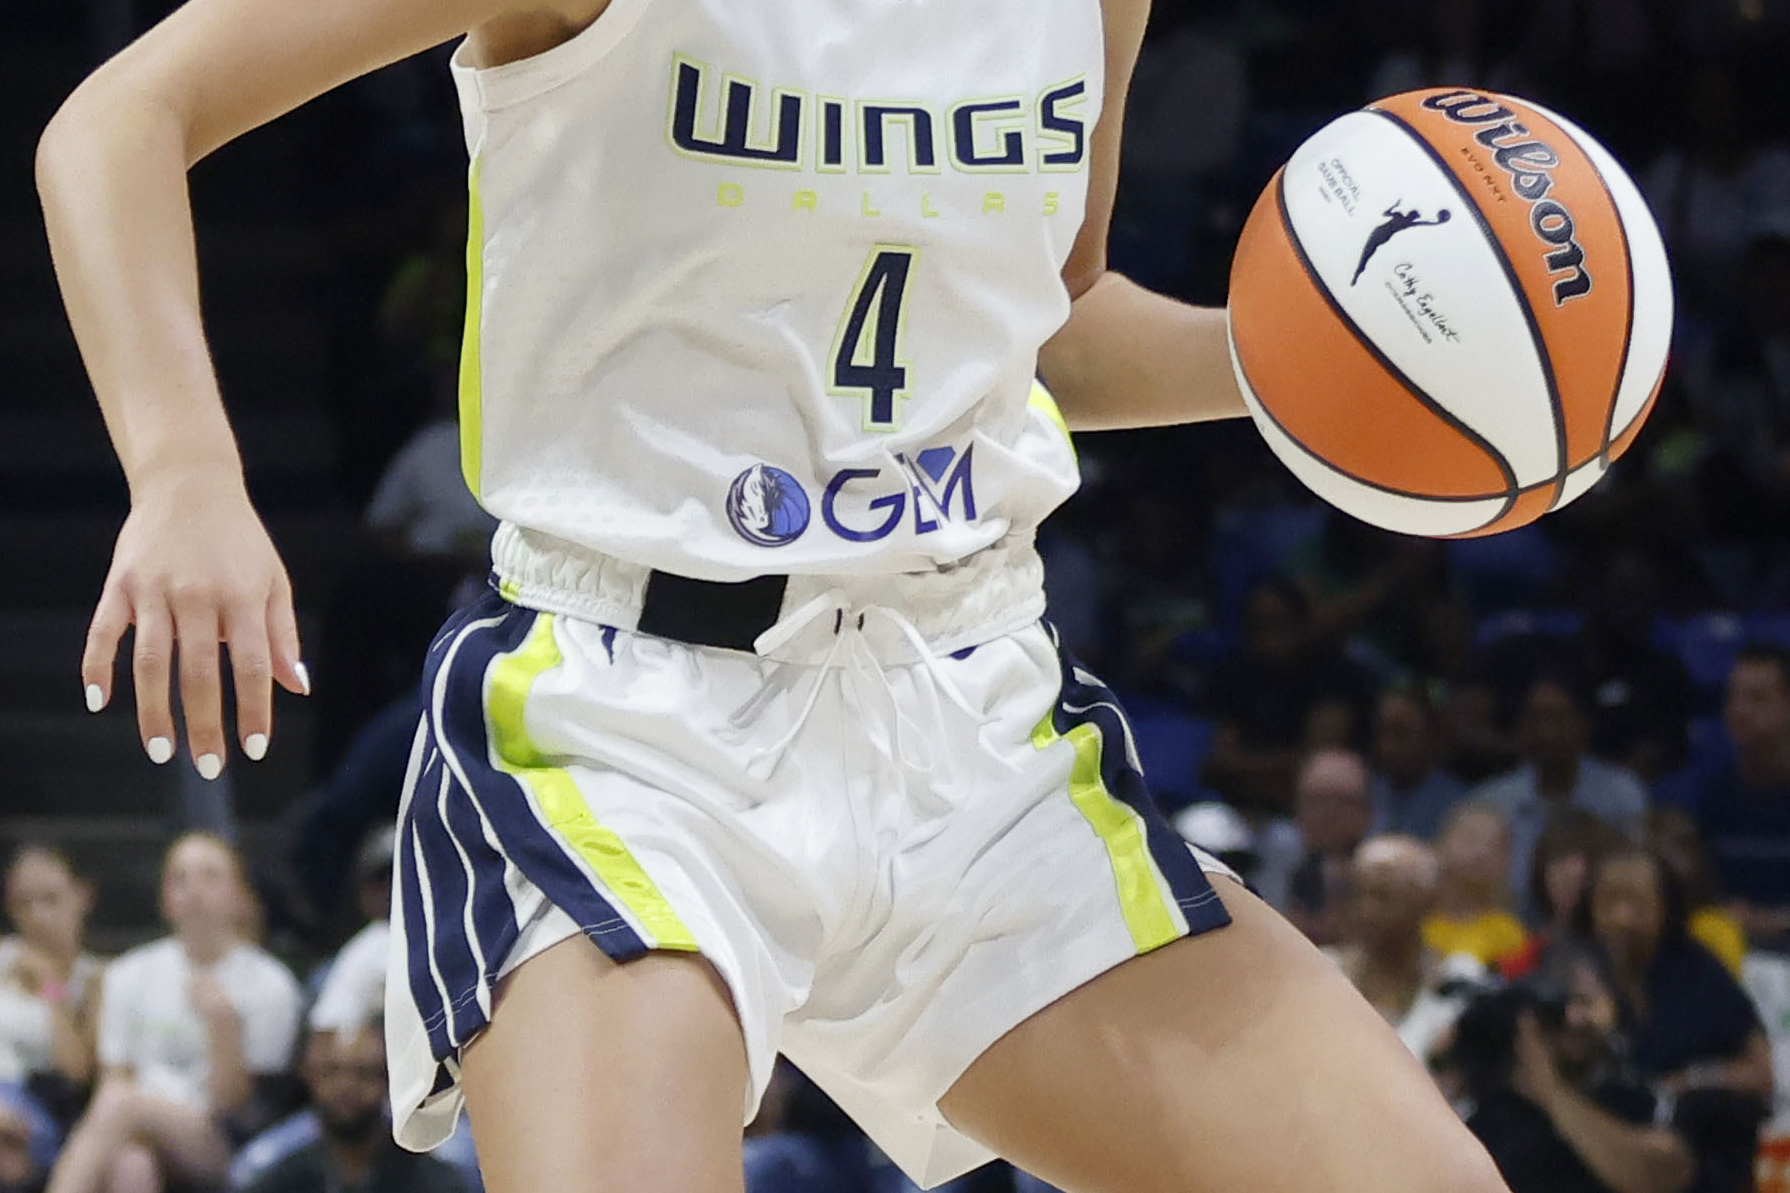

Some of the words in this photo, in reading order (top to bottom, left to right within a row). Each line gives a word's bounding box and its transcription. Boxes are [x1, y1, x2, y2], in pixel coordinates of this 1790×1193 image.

[716, 181, 1060, 218] DALLAS
[1420, 90, 1593, 307] Wilson
[825, 242, 922, 434] 4
